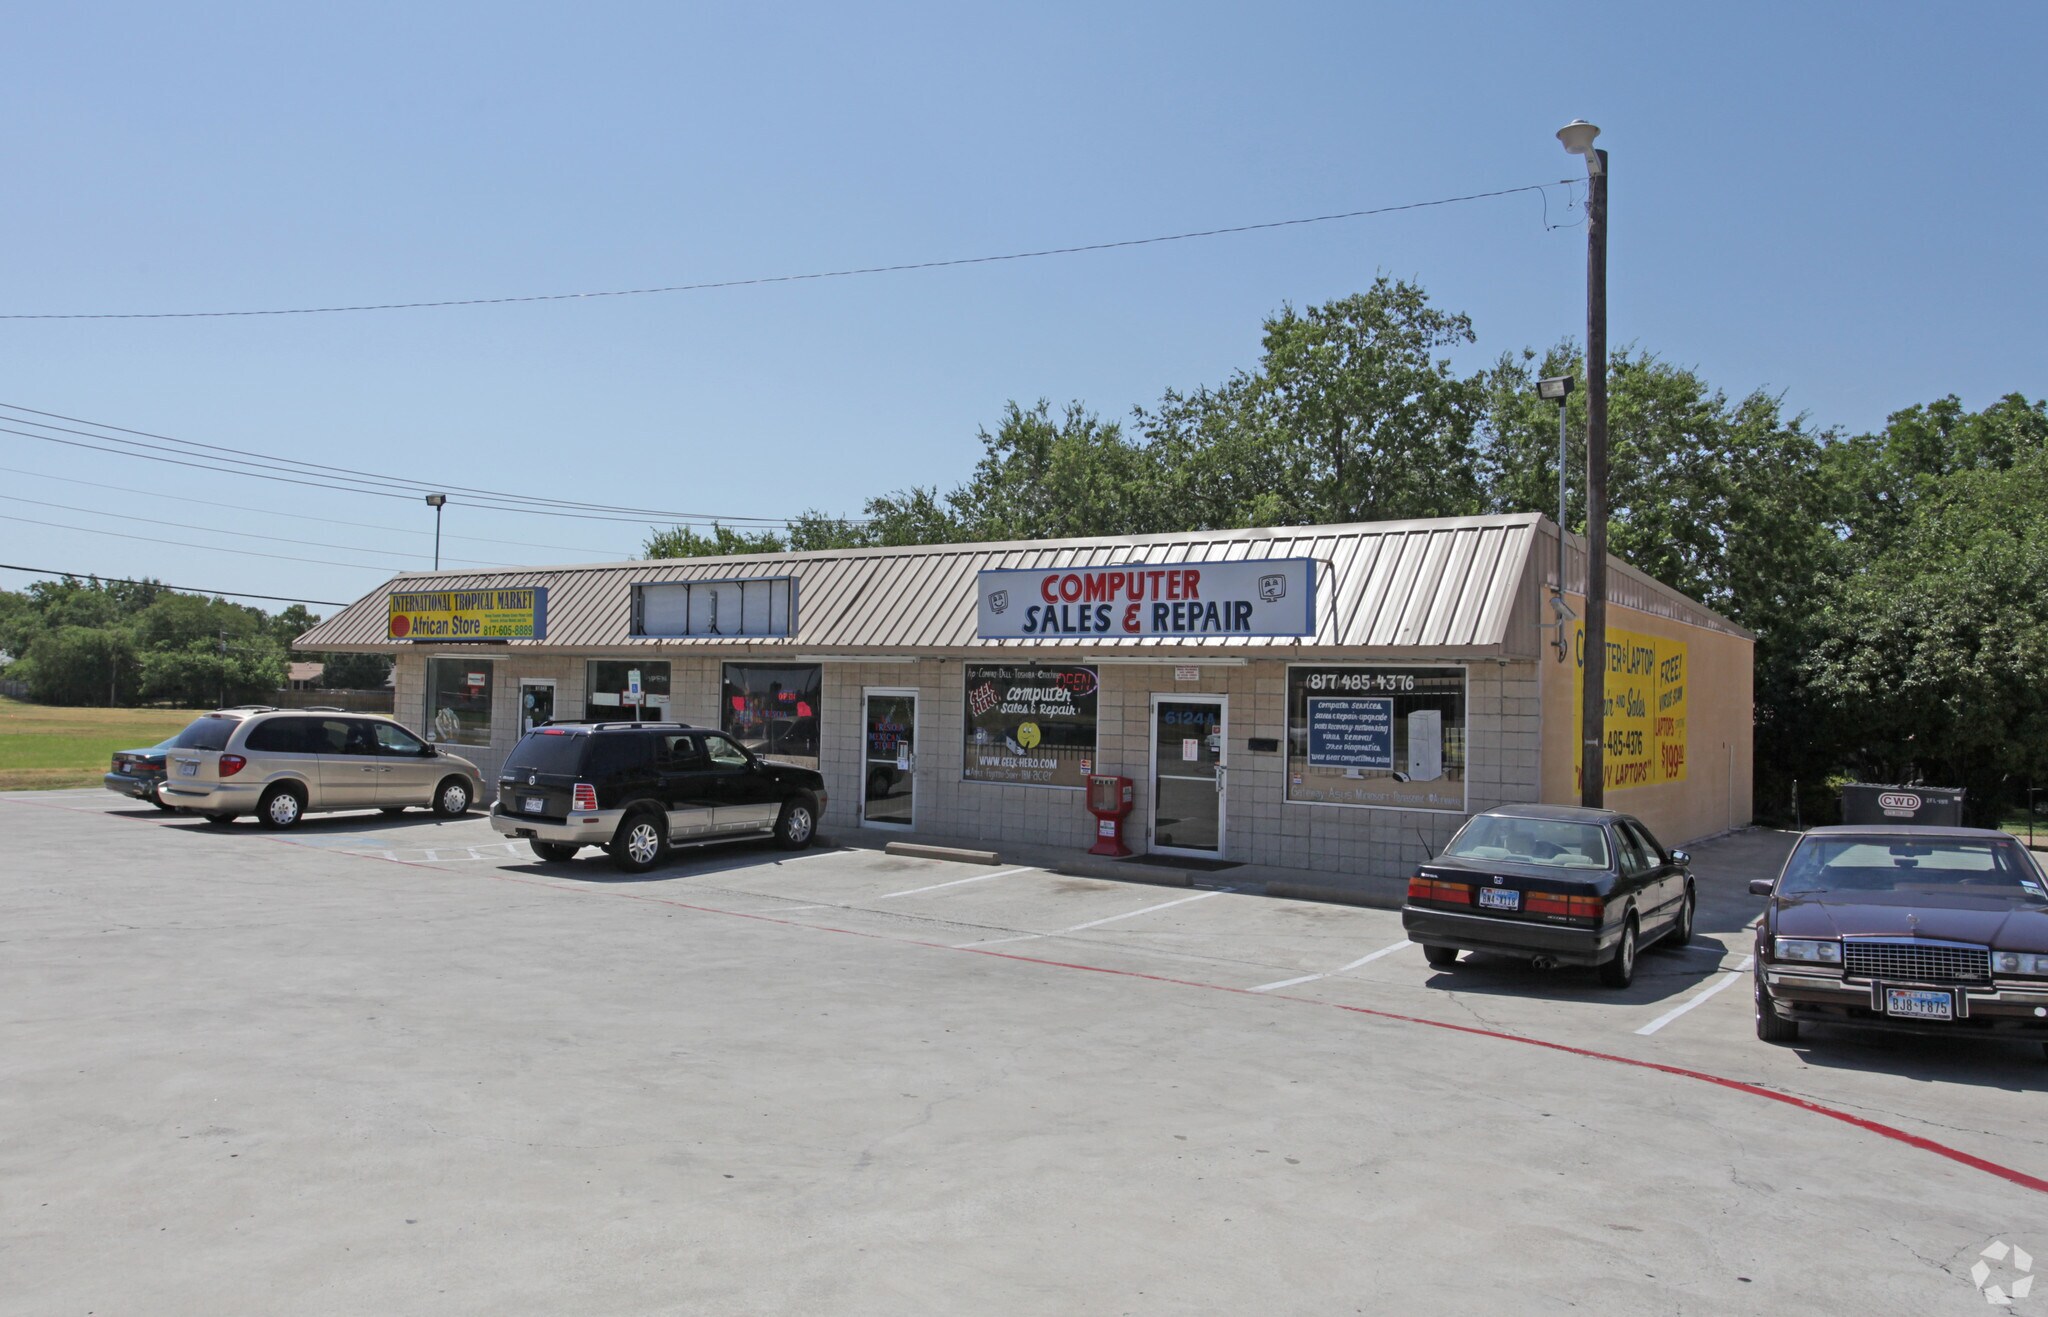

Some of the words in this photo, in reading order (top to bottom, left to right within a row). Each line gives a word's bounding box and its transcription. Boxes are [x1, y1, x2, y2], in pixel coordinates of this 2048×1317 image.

[392, 594, 451, 612] INTERNATIONAL
[454, 592, 494, 610] TROPICAL
[498, 590, 533, 609] MARKET
[1040, 570, 1200, 604] COMPUTER
[412, 616, 448, 635] African
[452, 615, 480, 635] Store
[1022, 604, 1113, 635] SALES
[1122, 603, 1141, 634] &
[1152, 600, 1254, 632] REPAIR
[1626, 639, 1653, 676] LAPTOP
[1660, 653, 1682, 688] FREE!
[980, 756, 1058, 769] WWW.GEEK-HERO.COM
[1884, 796, 1916, 806] CWD
